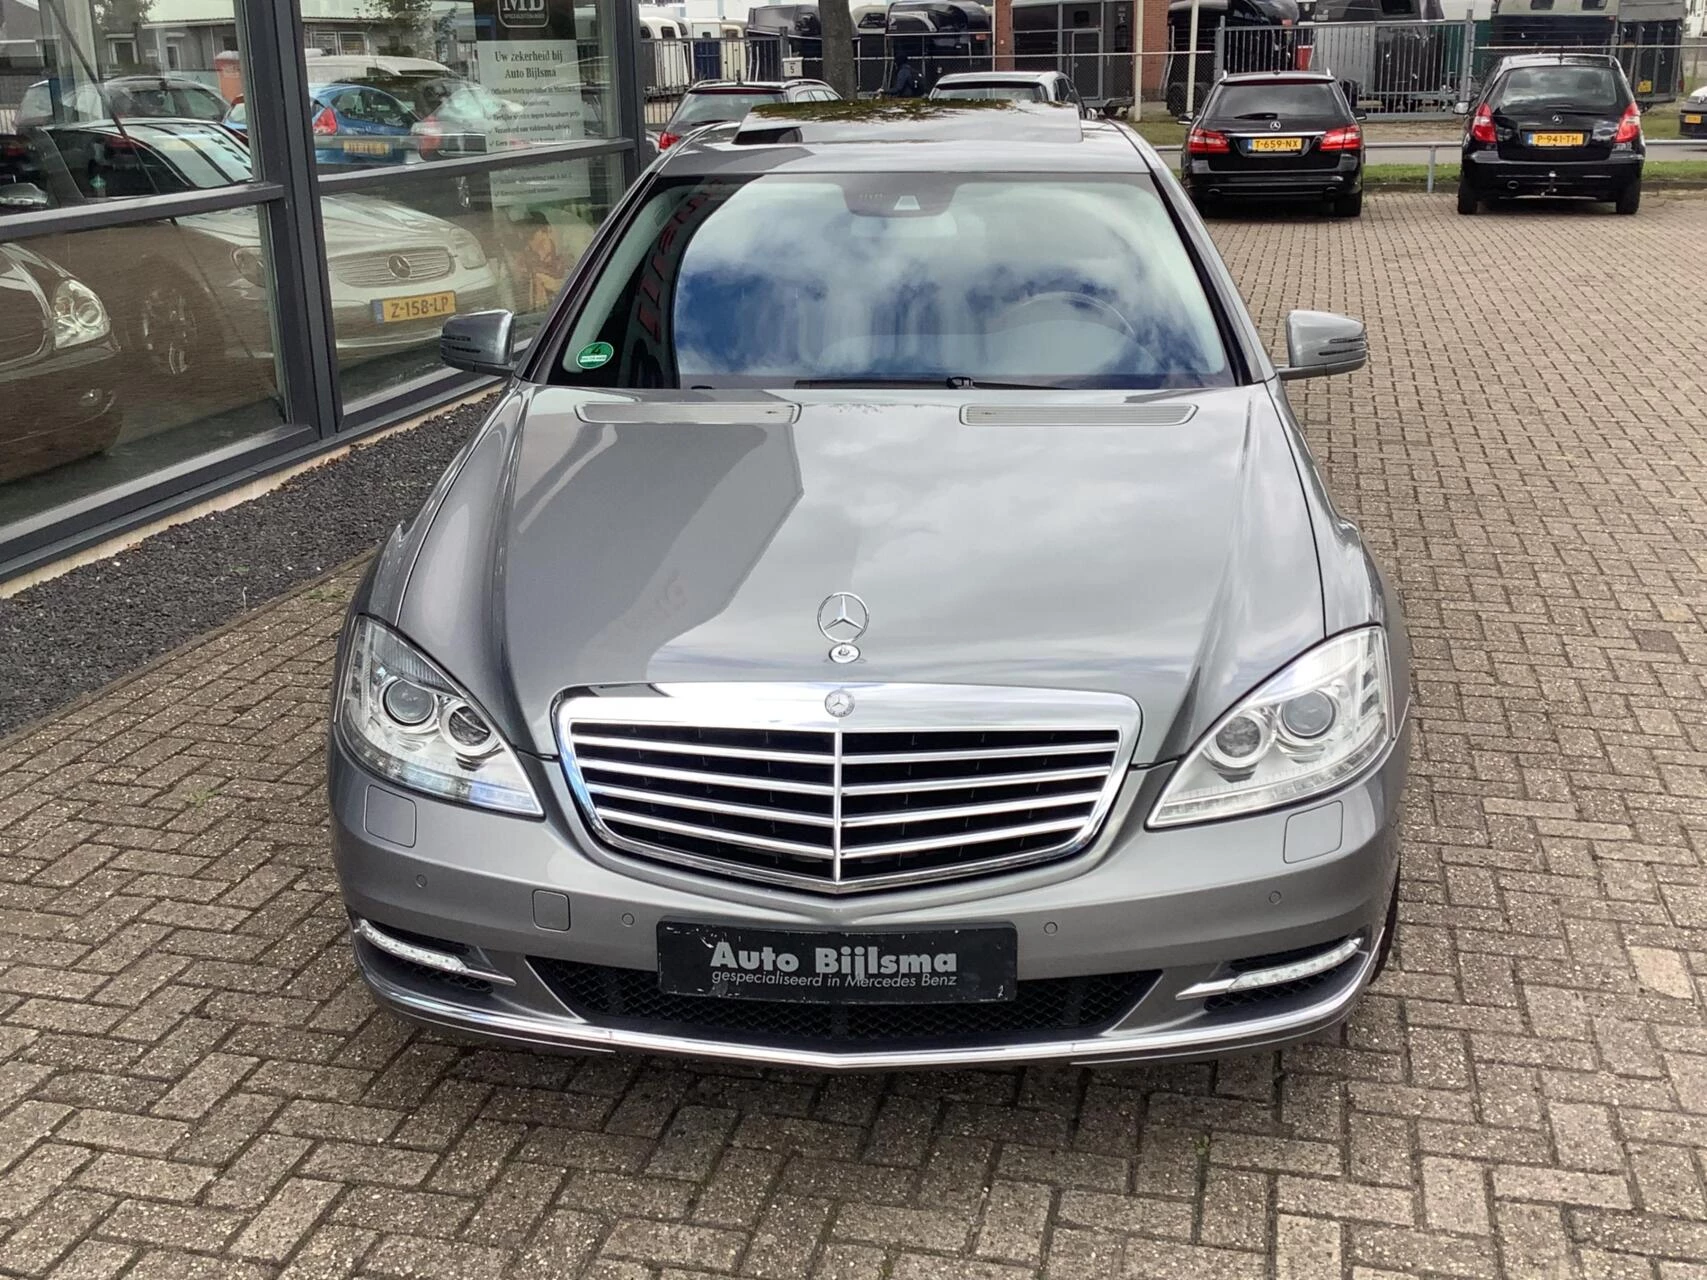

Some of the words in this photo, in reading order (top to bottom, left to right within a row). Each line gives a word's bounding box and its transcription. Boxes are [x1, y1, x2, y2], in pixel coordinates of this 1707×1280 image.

[495, 50, 509, 62] Uw
[511, 49, 550, 62] zekerheid
[552, 50, 563, 63] bij
[504, 69, 525, 79] Auto
[526, 67, 557, 80] Bijlsma
[1254, 140, 1299, 149] T-659-NX
[1536, 134, 1579, 144] P-941-TH
[391, 295, 449, 319] Z-158-LP
[709, 941, 800, 973] Auto
[815, 945, 958, 981] Bijlsma
[711, 969, 823, 987] gespecialiseerd
[827, 974, 841, 987] in
[844, 970, 917, 988] Mercedes
[920, 973, 958, 987] Benz
